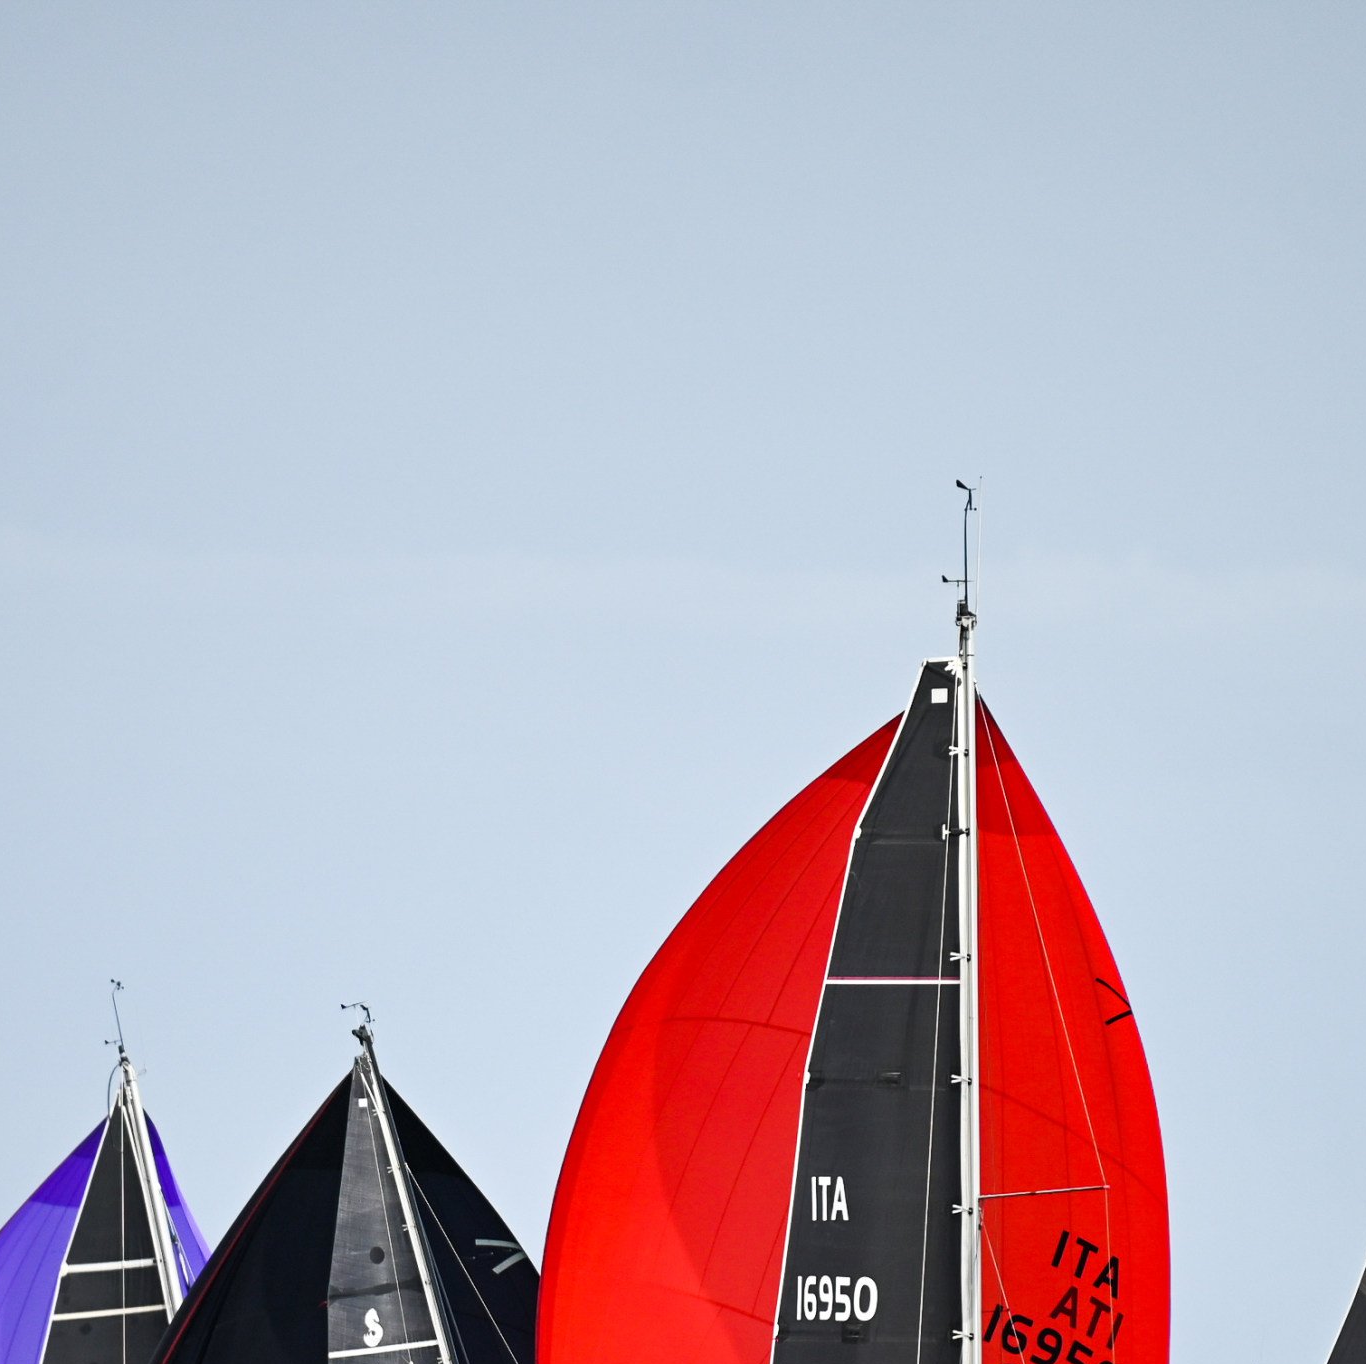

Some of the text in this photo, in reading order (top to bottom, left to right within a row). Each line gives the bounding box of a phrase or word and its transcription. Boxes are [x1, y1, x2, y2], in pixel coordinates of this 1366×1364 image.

[811, 1176, 849, 1221] ITA
[1051, 1230, 1119, 1299] ITA
[796, 1275, 878, 1321] 16950
